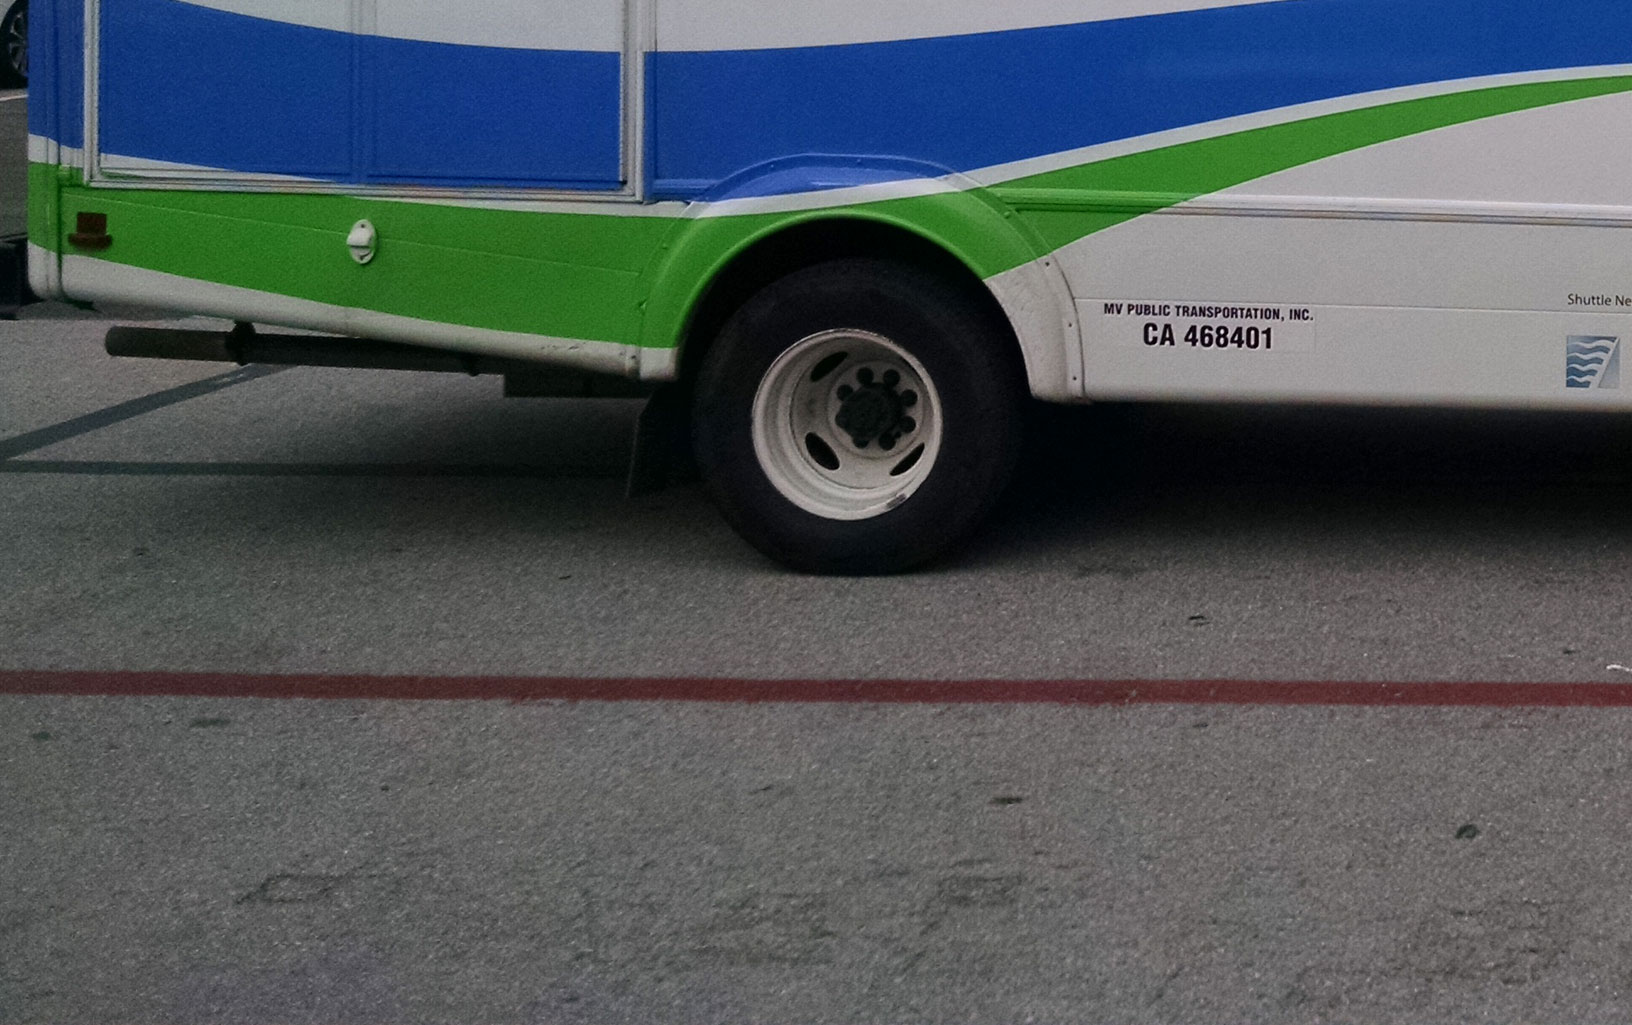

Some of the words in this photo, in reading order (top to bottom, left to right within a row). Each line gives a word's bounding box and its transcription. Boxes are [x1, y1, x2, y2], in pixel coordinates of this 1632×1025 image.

[1567, 293, 1612, 307] Shuttle
[1103, 303, 1123, 315] MV
[1127, 304, 1171, 317] PUBLIC
[1175, 305, 1285, 321] TRANSPORTATION,
[1289, 308, 1314, 321] INC.
[1143, 323, 1175, 346] CA
[1184, 326, 1273, 349] 468401
